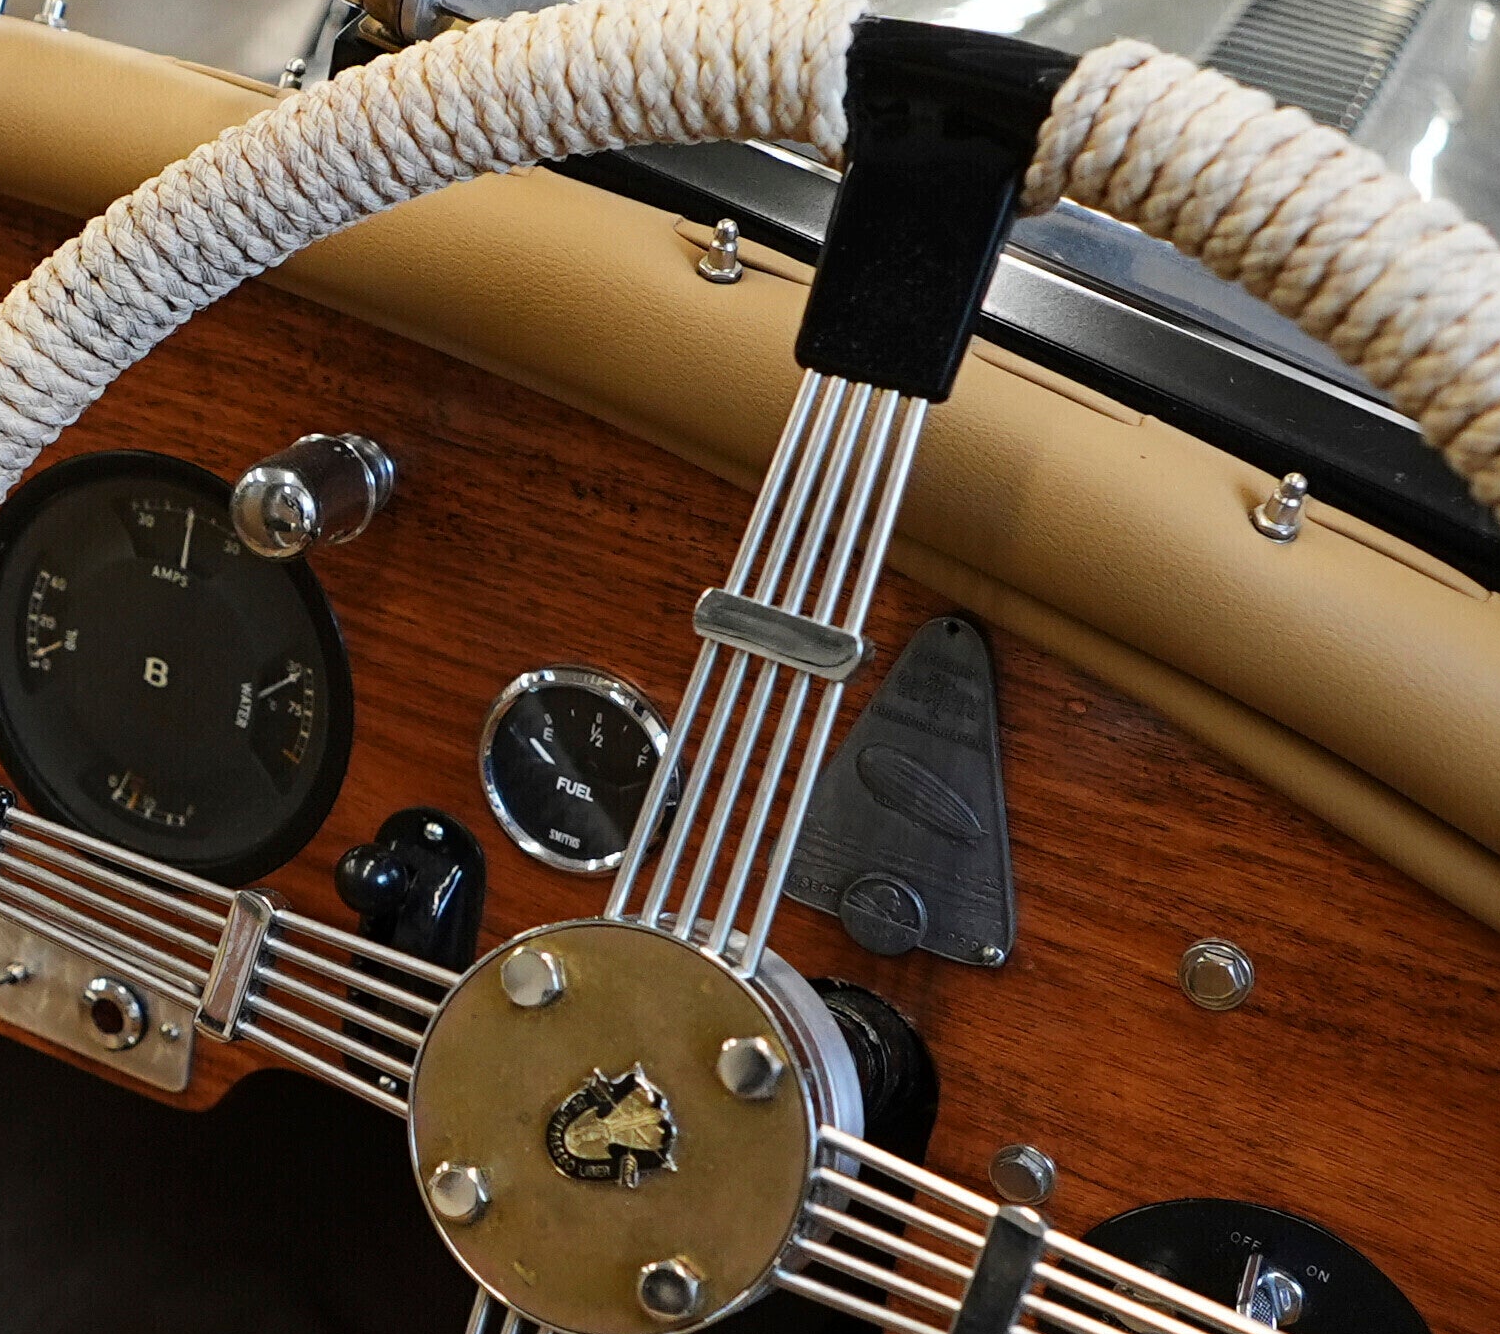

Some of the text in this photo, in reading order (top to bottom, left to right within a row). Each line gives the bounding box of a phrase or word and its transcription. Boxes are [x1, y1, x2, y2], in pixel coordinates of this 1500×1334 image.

[151, 565, 190, 589] AMPS
[142, 655, 170, 689] B
[235, 681, 254, 730] WATER
[543, 727, 554, 742] E
[637, 754, 648, 768] F
[555, 776, 594, 803] FUEL
[548, 828, 581, 849] SMITHS
[1230, 1231, 1263, 1250] OFF
[1305, 1264, 1331, 1283] ON
